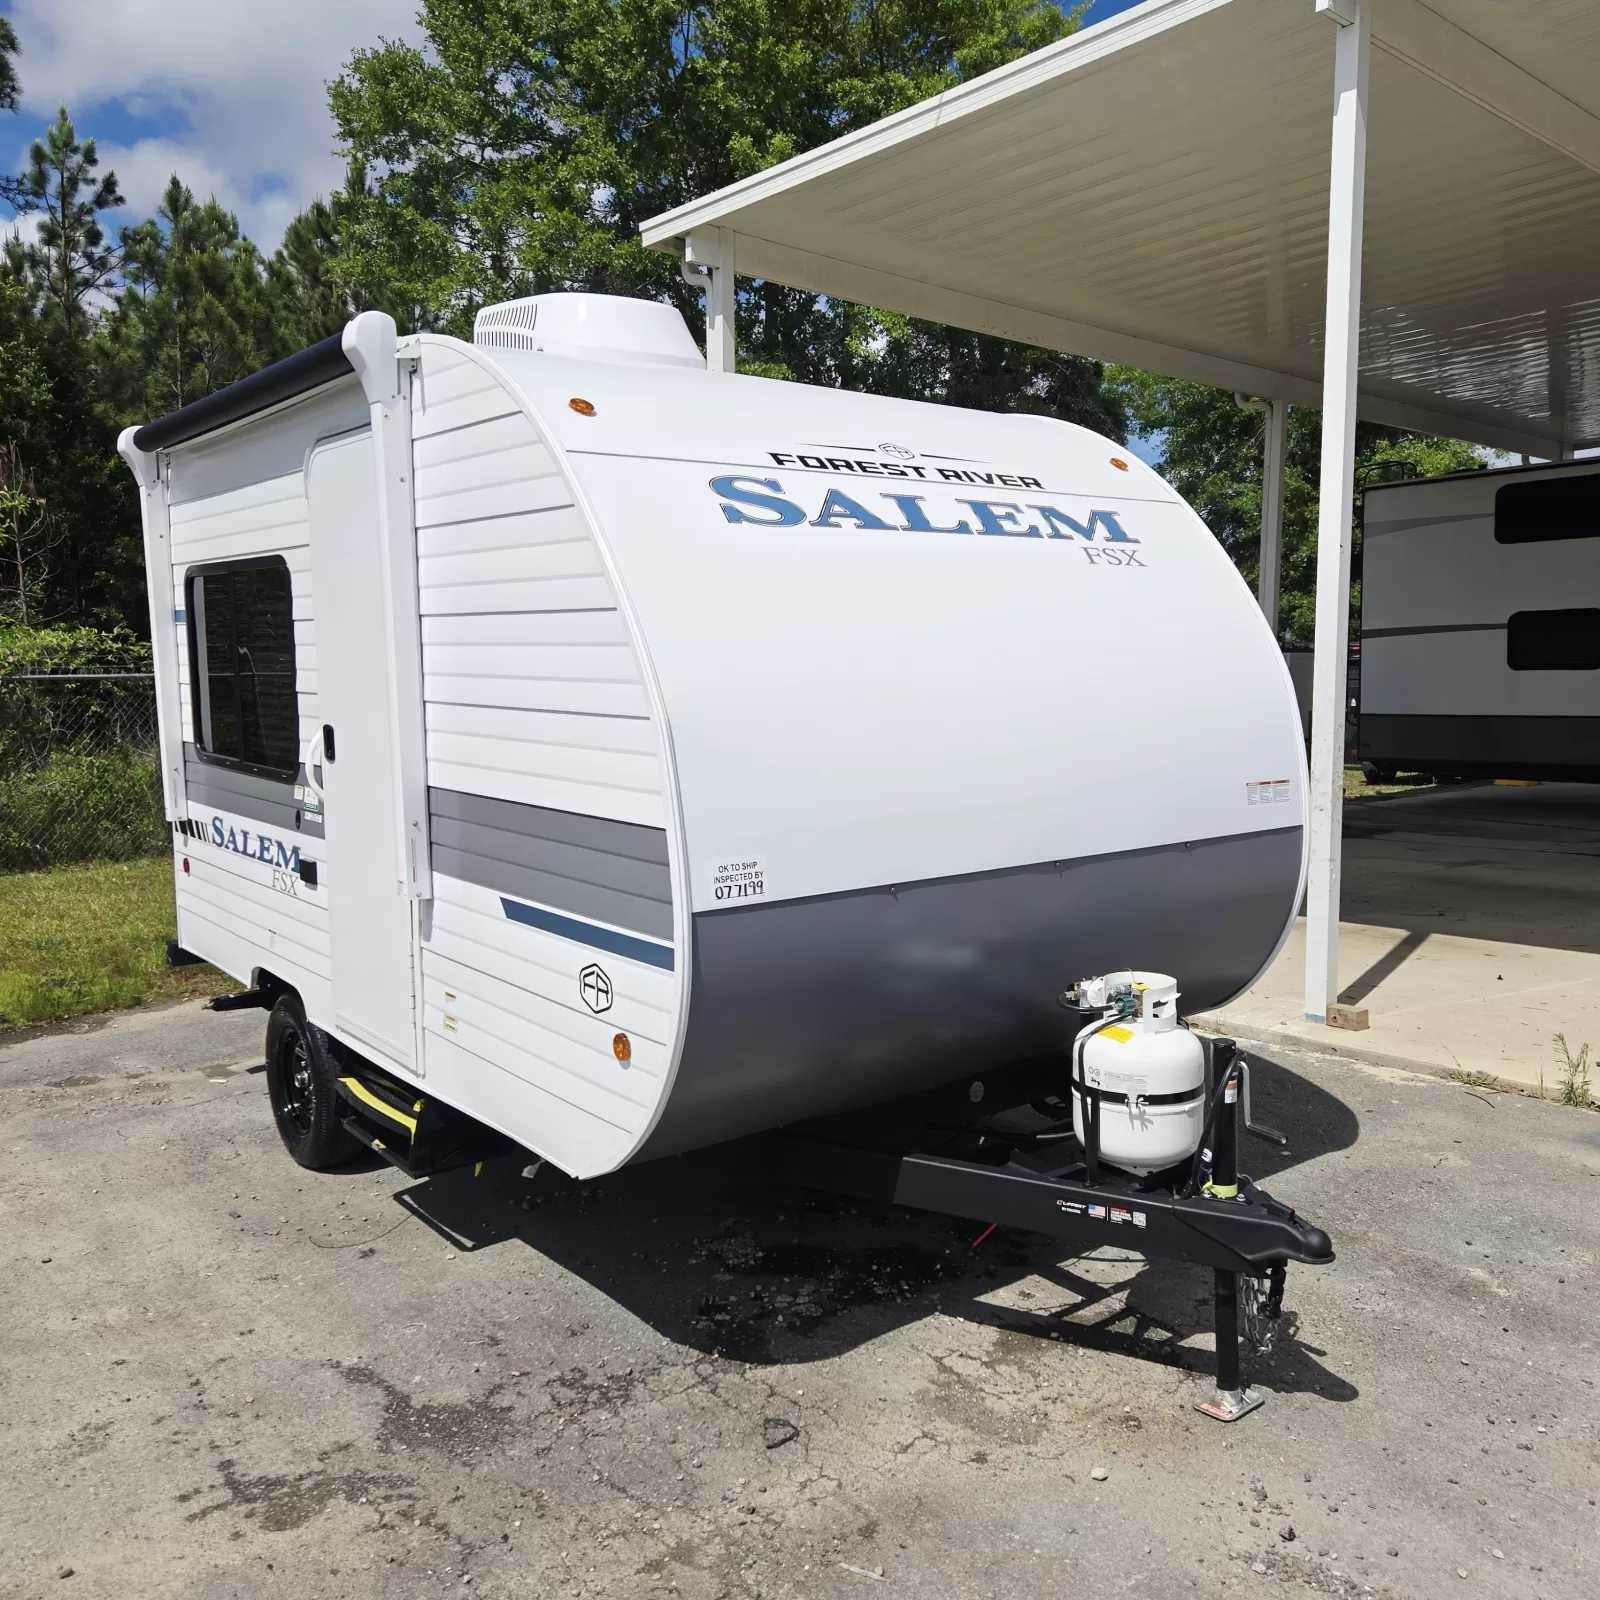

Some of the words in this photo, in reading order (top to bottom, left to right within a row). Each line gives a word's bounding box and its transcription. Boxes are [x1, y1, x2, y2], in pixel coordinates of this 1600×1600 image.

[766, 451, 928, 479] FOREST
[937, 466, 1046, 490] RIVER
[709, 474, 1142, 545] SALEM
[1080, 546, 1148, 568] FSX
[212, 815, 301, 874] SALEM
[713, 872, 753, 884] INSPECTED
[754, 871, 764, 879] BY
[718, 865, 729, 873] OK
[730, 863, 740, 871] TO
[741, 861, 758, 870] SHIP
[272, 868, 299, 896] FSX
